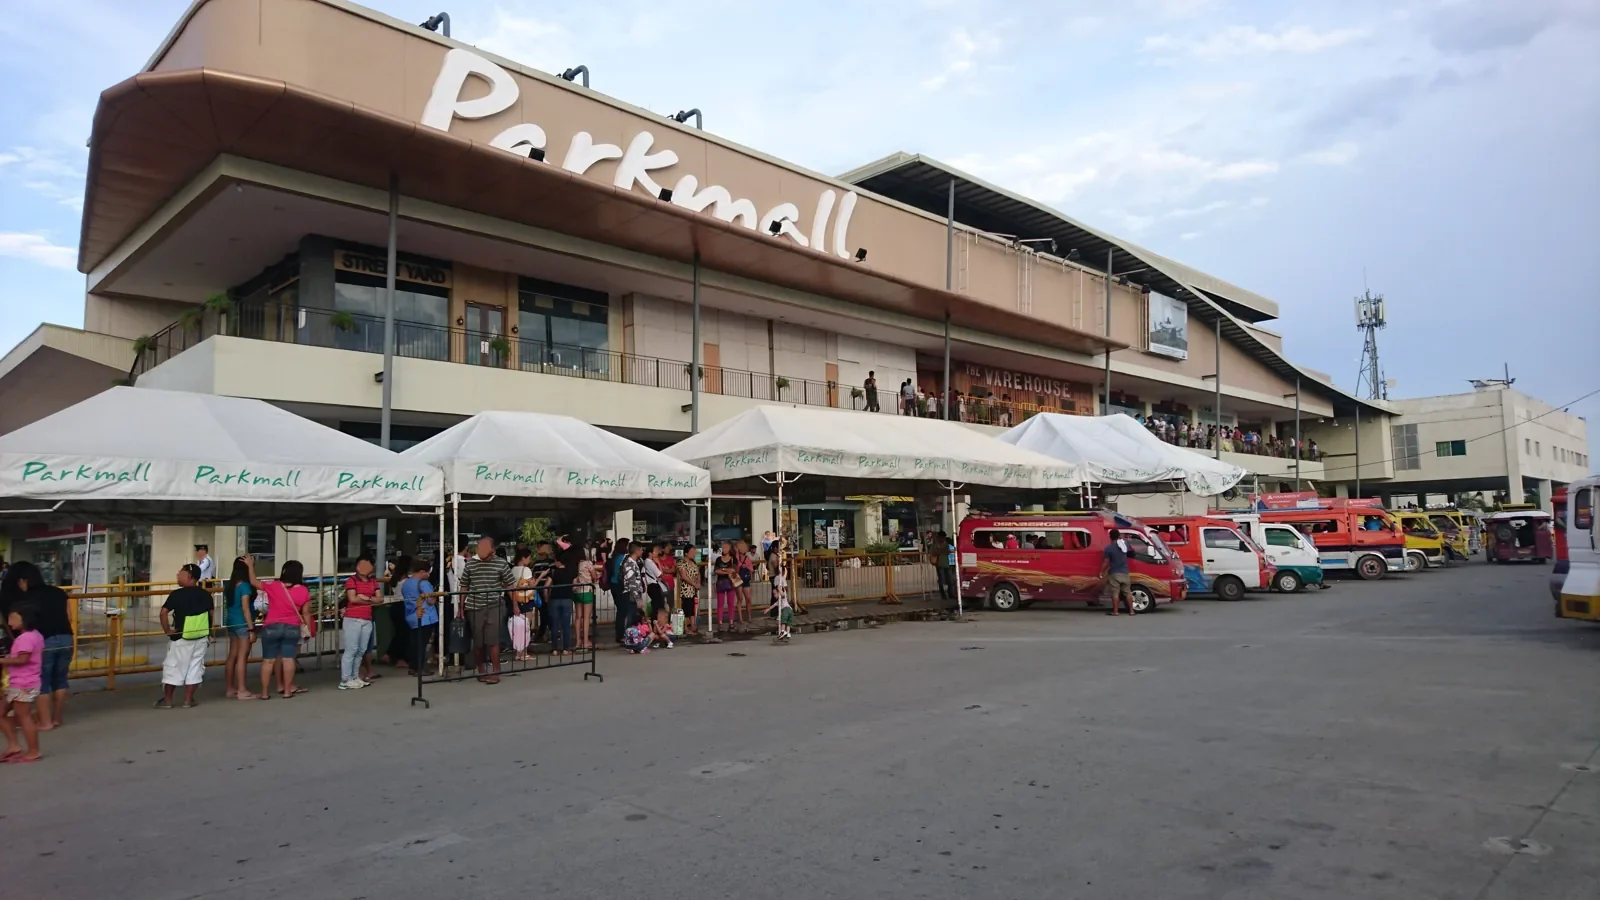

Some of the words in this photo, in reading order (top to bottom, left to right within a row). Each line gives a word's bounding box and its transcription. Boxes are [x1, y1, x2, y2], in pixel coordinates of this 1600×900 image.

[421, 48, 857, 259] Parkmall
[403, 263, 446, 284] YARD
[965, 364, 981, 377] THE
[984, 367, 1071, 398] WAREHOUSE
[724, 451, 769, 469] Parkmall
[797, 450, 843, 465] Parkmall
[858, 456, 901, 469] Parkmall
[914, 458, 951, 471] Parkmall
[22, 461, 151, 482] Parkmall
[194, 465, 301, 488] Parkmall
[475, 465, 544, 484] Parkmall
[337, 472, 424, 491] Parkmall
[647, 474, 698, 489] Parkmall
